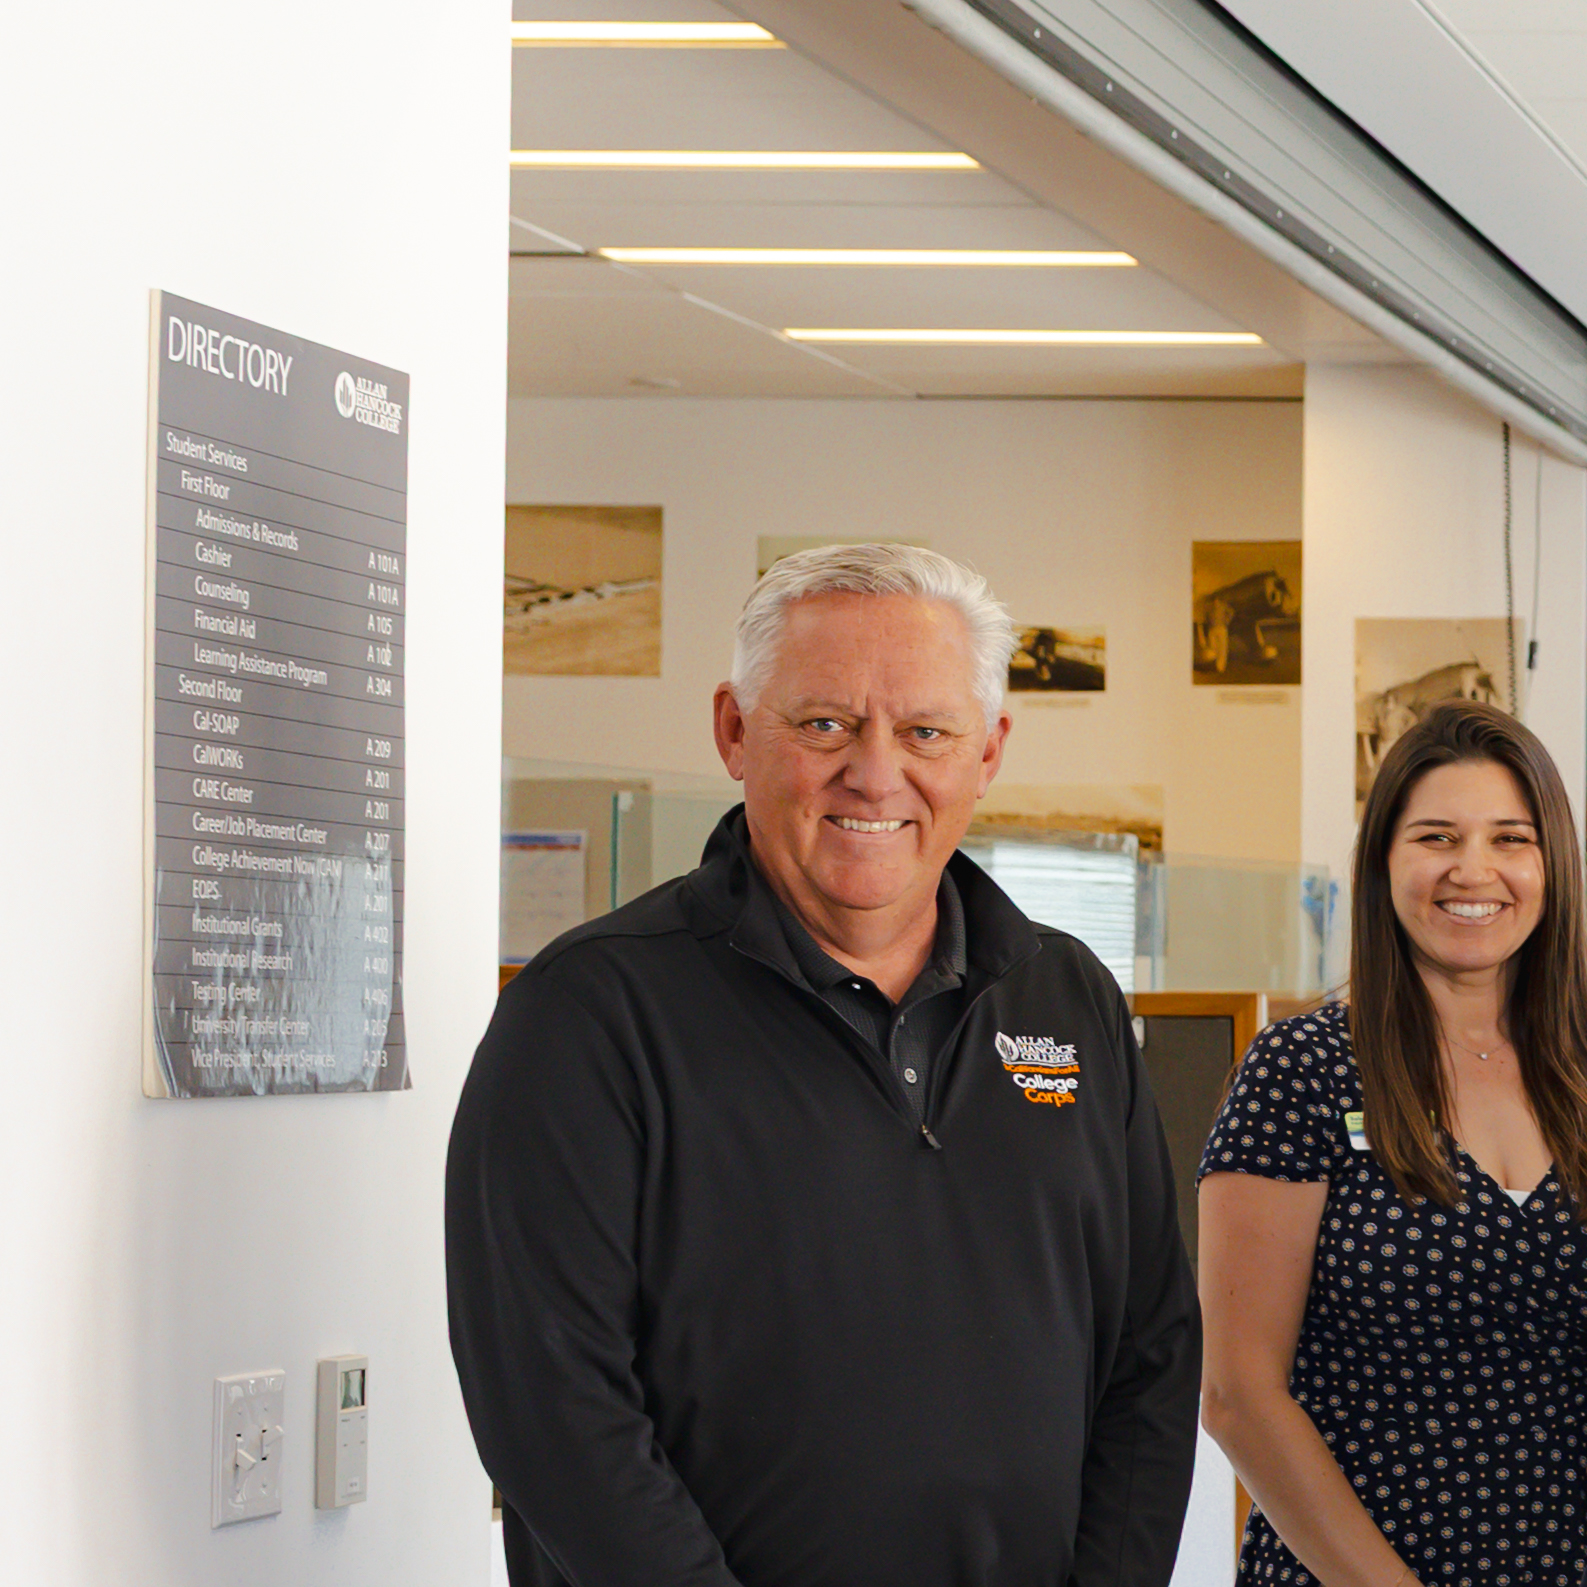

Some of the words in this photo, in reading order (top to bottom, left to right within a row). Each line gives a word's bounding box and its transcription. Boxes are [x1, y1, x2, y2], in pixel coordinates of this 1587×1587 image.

[168, 316, 293, 396] DIRECTORY
[355, 377, 388, 400] ALLAN
[355, 391, 402, 420] HANCOCK
[355, 407, 400, 434] COLLEGE
[166, 432, 206, 461] Student
[208, 444, 248, 472] Services
[181, 470, 203, 494] First
[204, 476, 230, 500] Floor
[195, 508, 251, 540] Admissions
[251, 522, 260, 541] &
[261, 524, 298, 551] Records
[368, 552, 376, 569] A
[378, 556, 400, 575] 101A
[195, 541, 232, 568] Cashier
[368, 582, 376, 601] A
[377, 585, 400, 606] 101A
[194, 575, 250, 610] Counseling
[367, 614, 375, 632] A
[376, 616, 393, 635] 105
[194, 608, 238, 636] Financial
[239, 618, 256, 640] Aid
[367, 645, 375, 663] A
[194, 642, 238, 674] Learning
[238, 652, 287, 679] Assistance
[288, 660, 328, 687] Program
[366, 676, 374, 694] A
[375, 678, 392, 697] 304
[178, 673, 216, 699] Second
[217, 680, 243, 703] Floor
[193, 710, 240, 735] Cal-SOAP
[365, 738, 373, 756] A
[374, 739, 392, 758] 209
[193, 744, 244, 769] CalWORKs
[365, 769, 373, 787] A
[374, 770, 390, 789] 201
[192, 778, 220, 800] CARE
[220, 782, 254, 803] Center
[365, 800, 373, 818] A
[374, 801, 390, 820] 201
[192, 812, 246, 836] Career/Job
[246, 818, 296, 841] Placement
[297, 823, 328, 844] Center
[364, 831, 373, 850] A
[373, 832, 390, 851] 207
[192, 845, 230, 872] College
[231, 850, 293, 873] Achievement
[293, 855, 315, 874] Now
[364, 863, 372, 880] A
[192, 879, 219, 900] EOPS
[364, 894, 372, 911] A
[192, 913, 250, 936] Institutional
[251, 916, 283, 938] Grants
[364, 925, 371, 942] A
[192, 947, 250, 968] Institutional
[251, 950, 293, 971] Research
[363, 956, 371, 973] A
[192, 981, 227, 1005] Testing
[228, 982, 260, 1002] Center
[192, 1015, 238, 1038] University
[240, 1015, 278, 1035] Transfer
[279, 1017, 310, 1036] Center
[1015, 1035, 1055, 1047] ALLAN
[1019, 1043, 1077, 1055] HANCOCK
[1013, 1073, 1078, 1094] College
[1024, 1088, 1075, 1107] Corps
